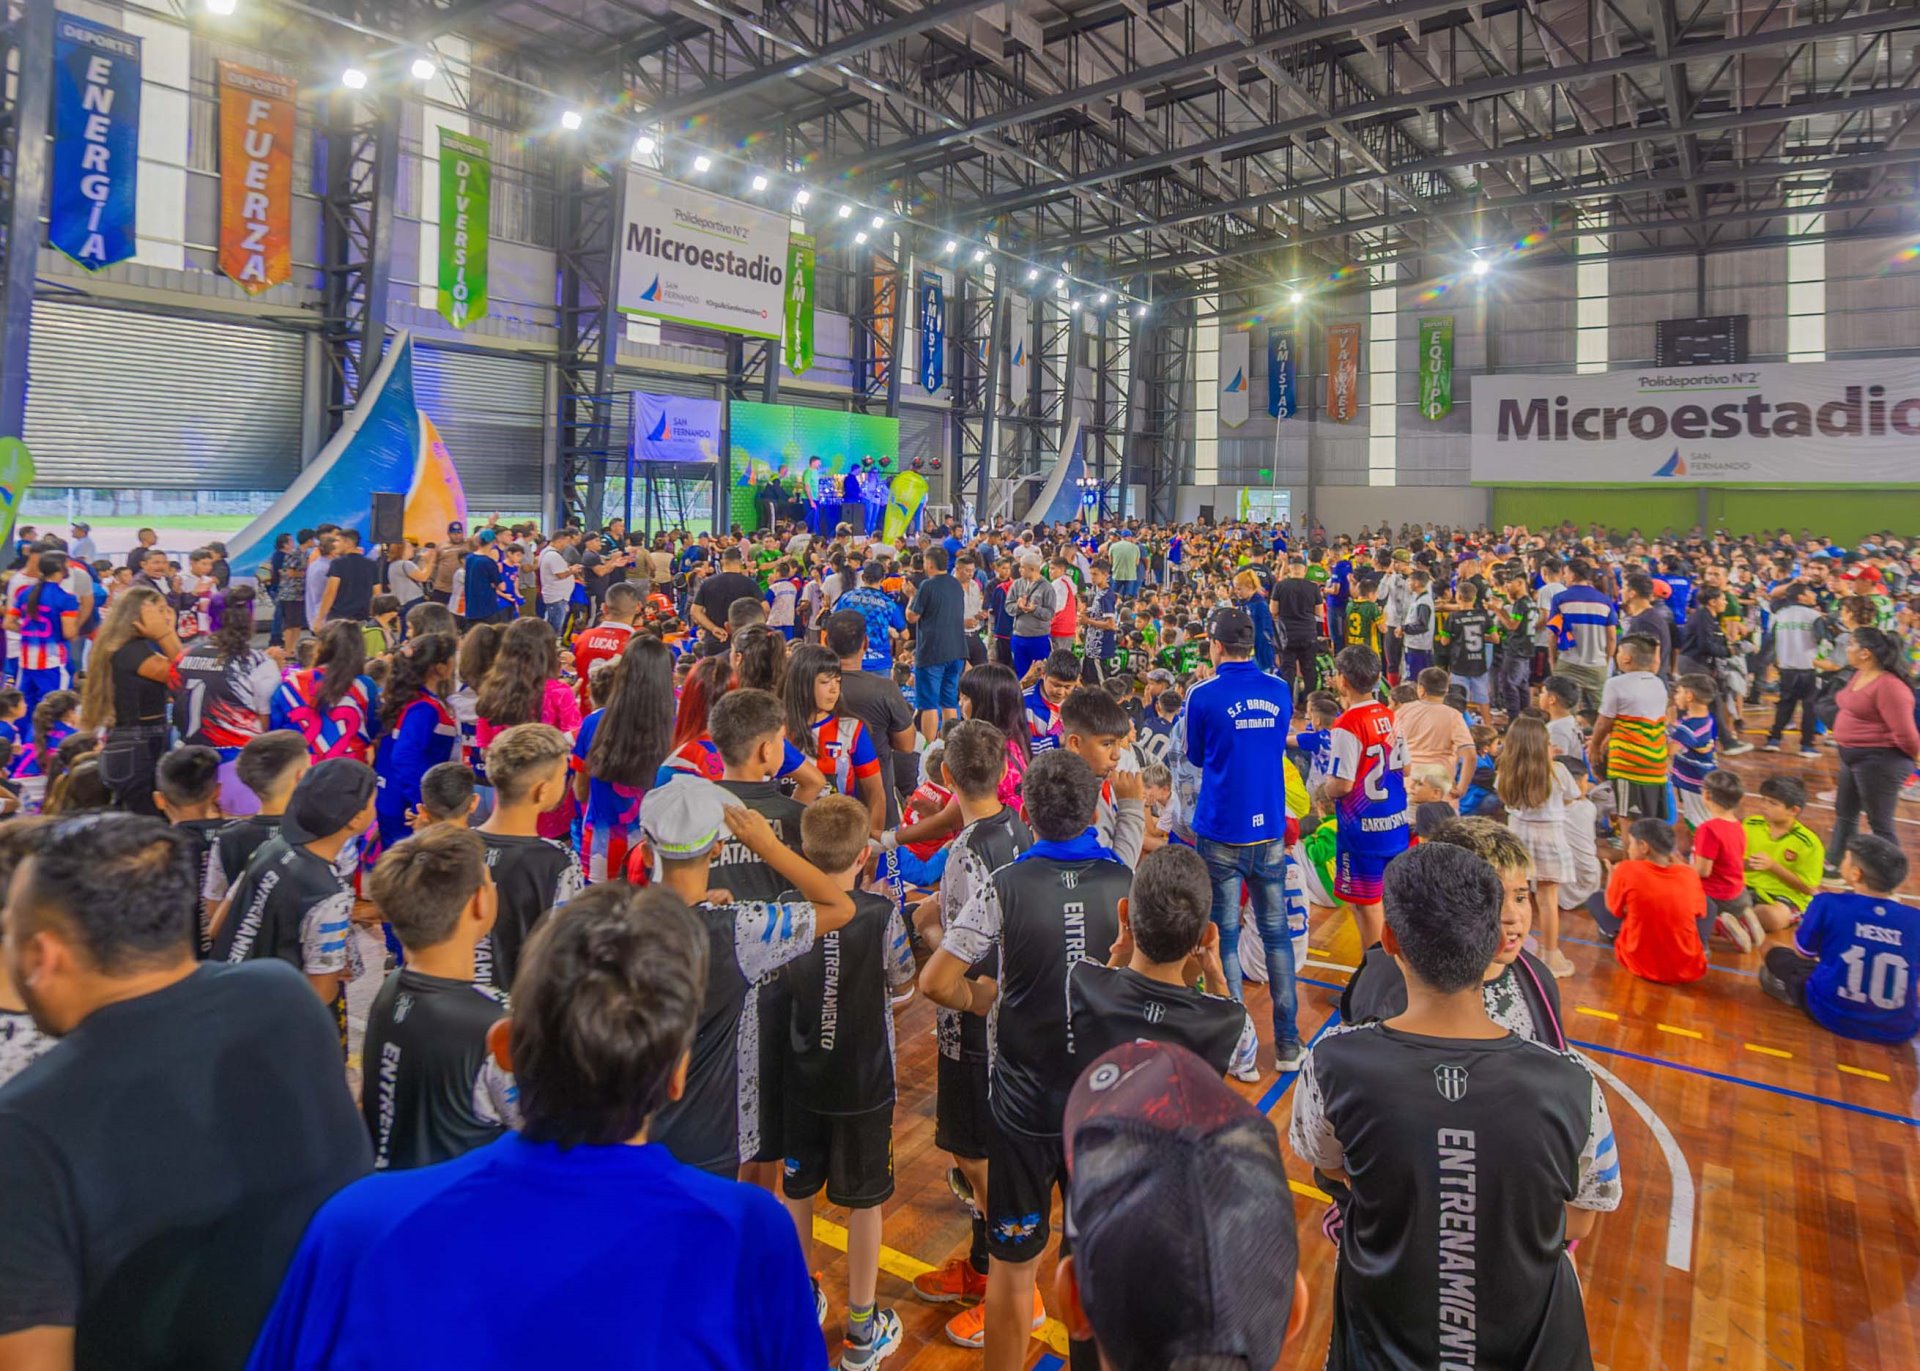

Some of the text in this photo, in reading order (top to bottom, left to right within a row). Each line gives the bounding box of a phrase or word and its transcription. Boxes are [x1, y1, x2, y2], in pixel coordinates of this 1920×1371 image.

[63, 23, 136, 56] DEPORTE
[228, 71, 290, 98] DEPORTE
[79, 55, 114, 261] ENERGÍA
[240, 98, 273, 283] FUERZA
[626, 223, 783, 286] Microestadio
[664, 289, 700, 304] FERNANDO
[927, 289, 937, 389] AMISTAD
[1277, 339, 1289, 418] AMISTAD
[1338, 337, 1350, 418] VALORES
[1429, 331, 1442, 417] EQUIPO
[673, 416, 688, 426] SAN
[1497, 384, 1920, 441] Microestadio
[673, 427, 710, 439] FERNANDO
[1690, 451, 1712, 460] SAN
[1690, 461, 1751, 471] FERNANDO
[1349, 612, 1361, 635] 3
[589, 636, 620, 650] LUCAS
[1463, 624, 1482, 651] 5
[1110, 656, 1121, 676] 9
[1227, 698, 1280, 718] S.F. BARRIO
[1855, 922, 1903, 946] MESSI
[821, 930, 840, 1050] ENTRENAMIENTO
[1837, 944, 1910, 1009] 10
